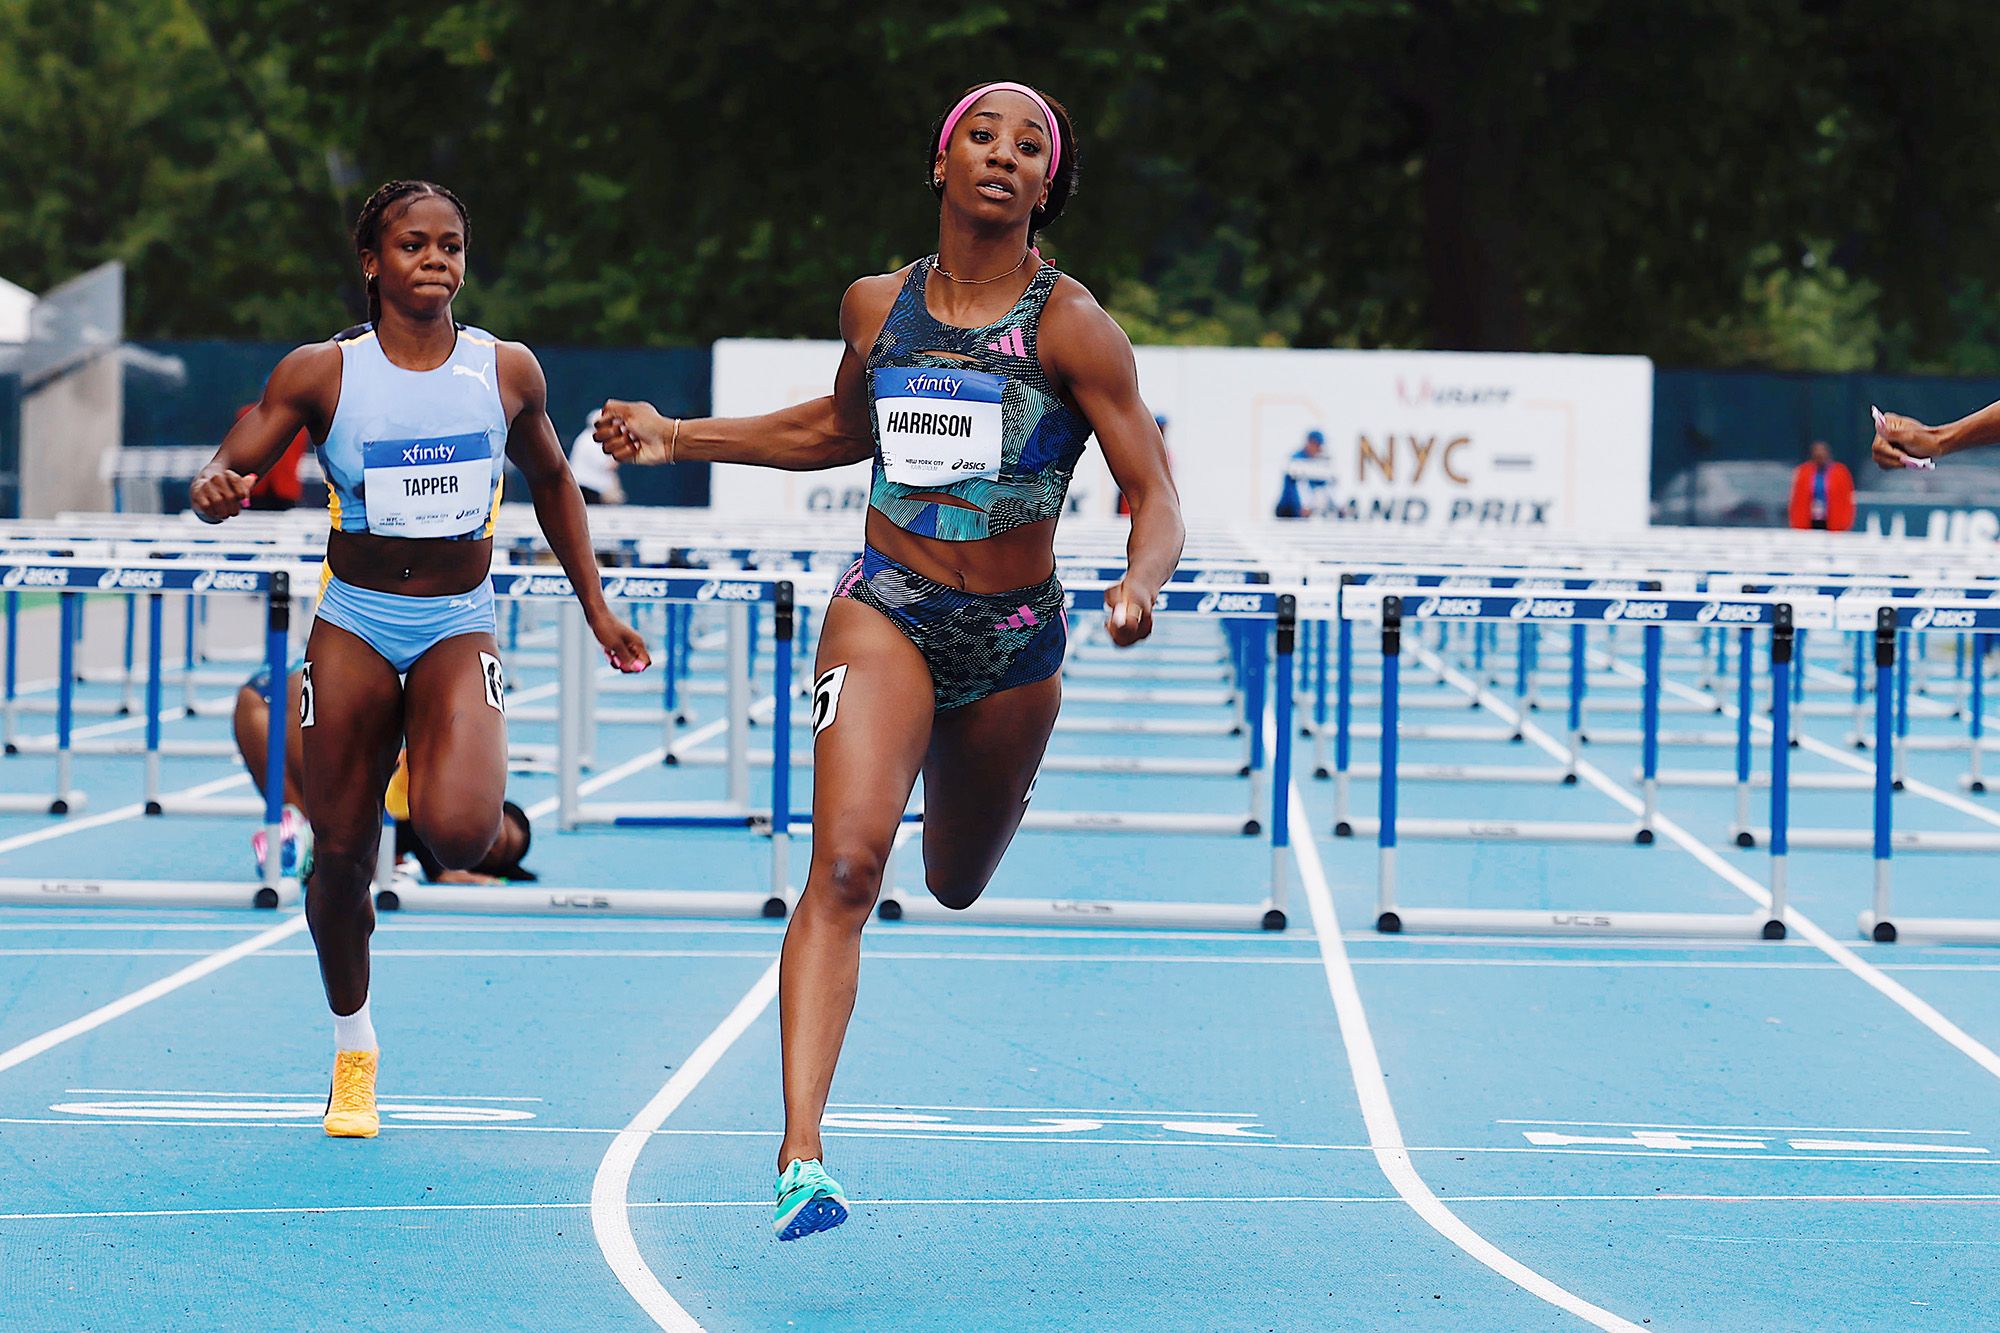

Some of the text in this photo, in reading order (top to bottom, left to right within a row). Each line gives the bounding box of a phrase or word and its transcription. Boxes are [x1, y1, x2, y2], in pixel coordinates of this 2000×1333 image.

[905, 373, 963, 396] xfinity
[886, 411, 972, 437] HARRISON
[402, 443, 456, 464] xfinity
[1359, 434, 1471, 484] NYC
[403, 475, 459, 496] TAPPER
[1451, 498, 1549, 524] PRIX
[1552, 915, 1612, 927] UCS
